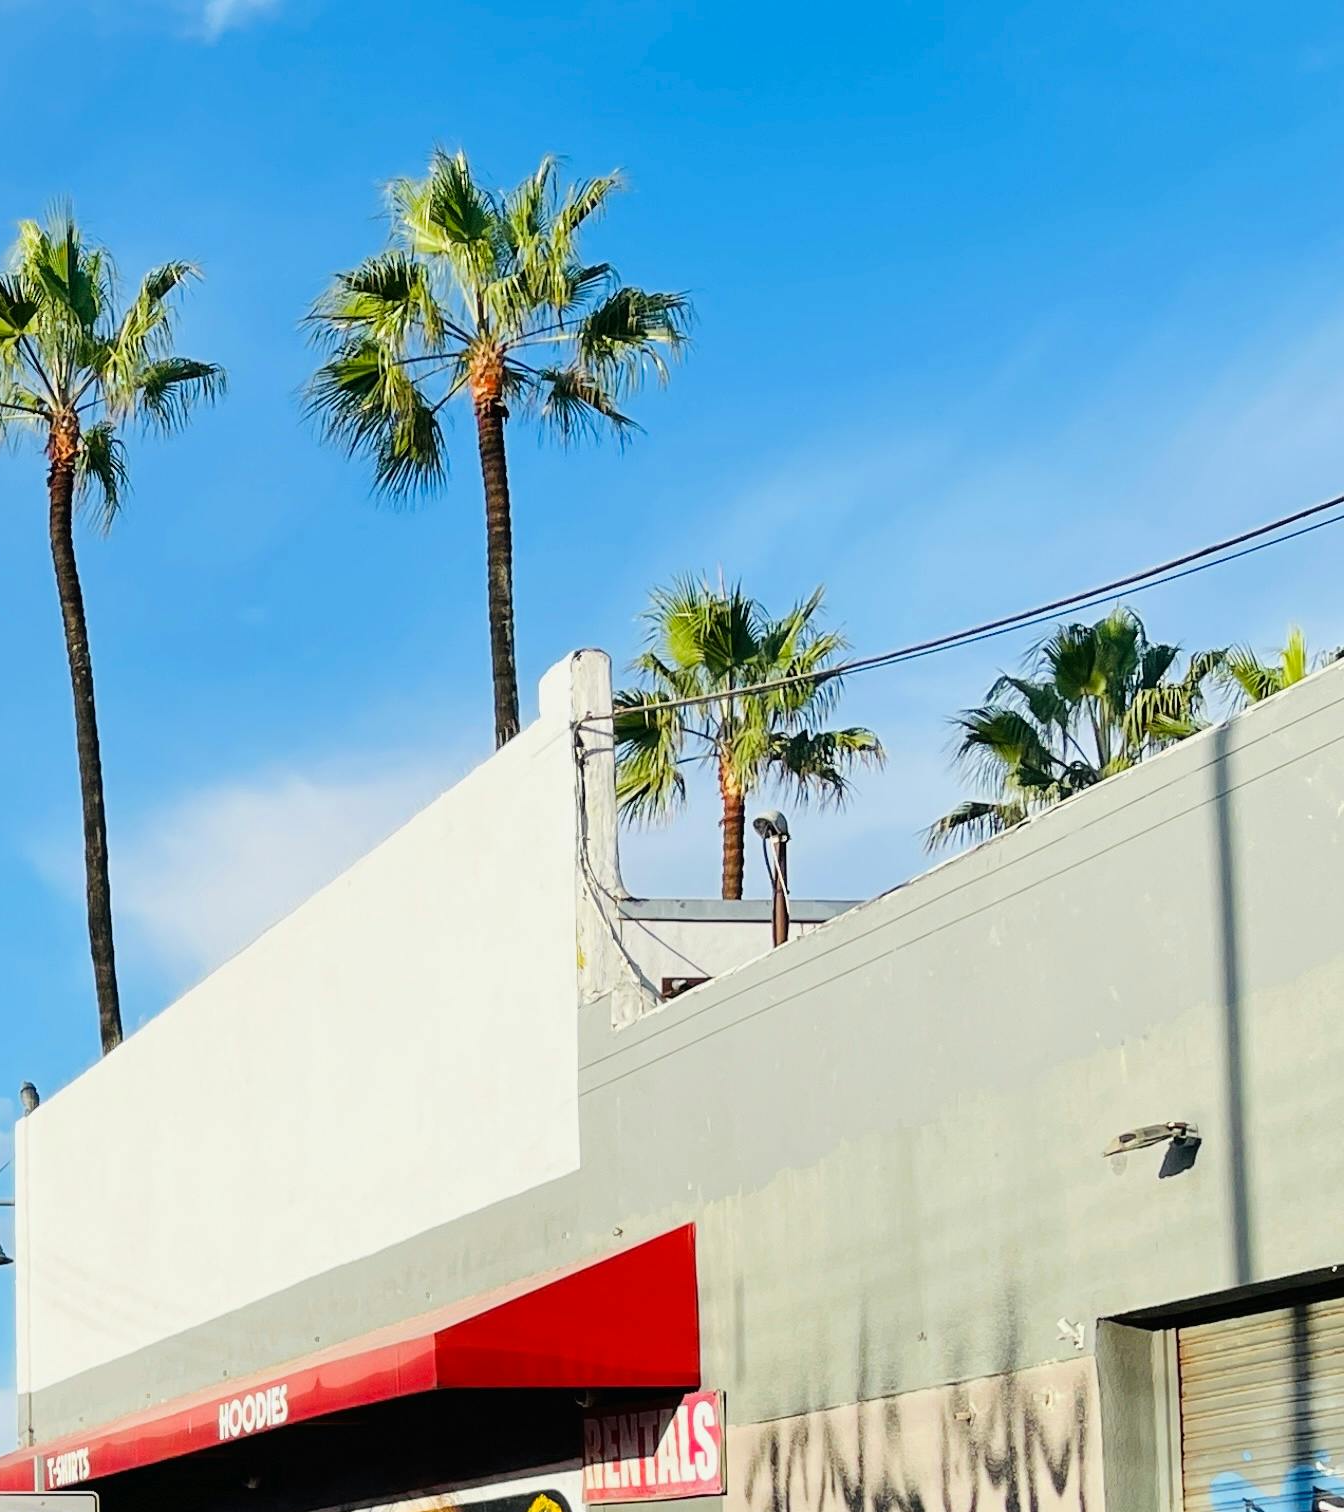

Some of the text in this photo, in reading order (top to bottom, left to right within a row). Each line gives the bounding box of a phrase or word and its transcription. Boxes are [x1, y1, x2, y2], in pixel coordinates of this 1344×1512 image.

[218, 1383, 288, 1441] HOODIES
[46, 1446, 90, 1489] T-SHIRTS
[583, 1399, 719, 1490] RENTALS
